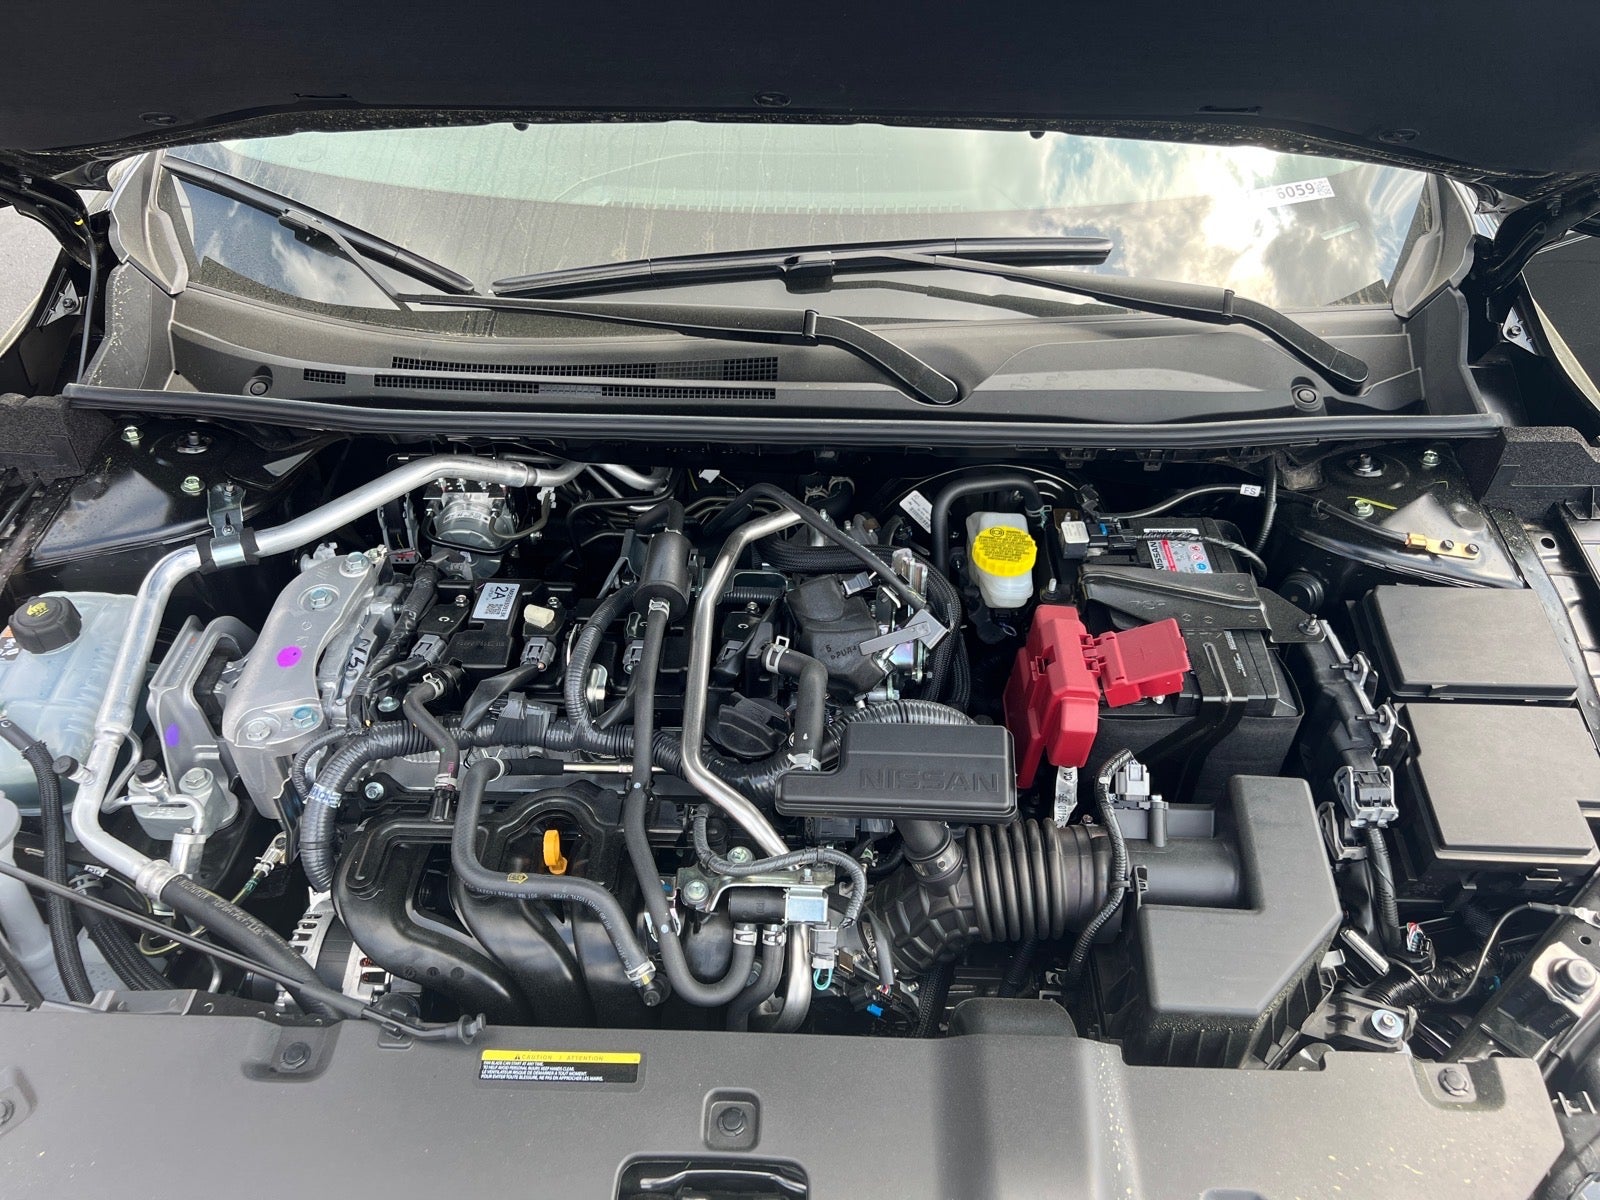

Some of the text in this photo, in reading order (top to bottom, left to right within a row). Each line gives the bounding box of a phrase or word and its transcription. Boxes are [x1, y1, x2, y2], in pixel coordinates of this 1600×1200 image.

[1244, 486, 1257, 496] FS
[491, 586, 509, 600] 2A
[860, 768, 999, 793] NISSAN
